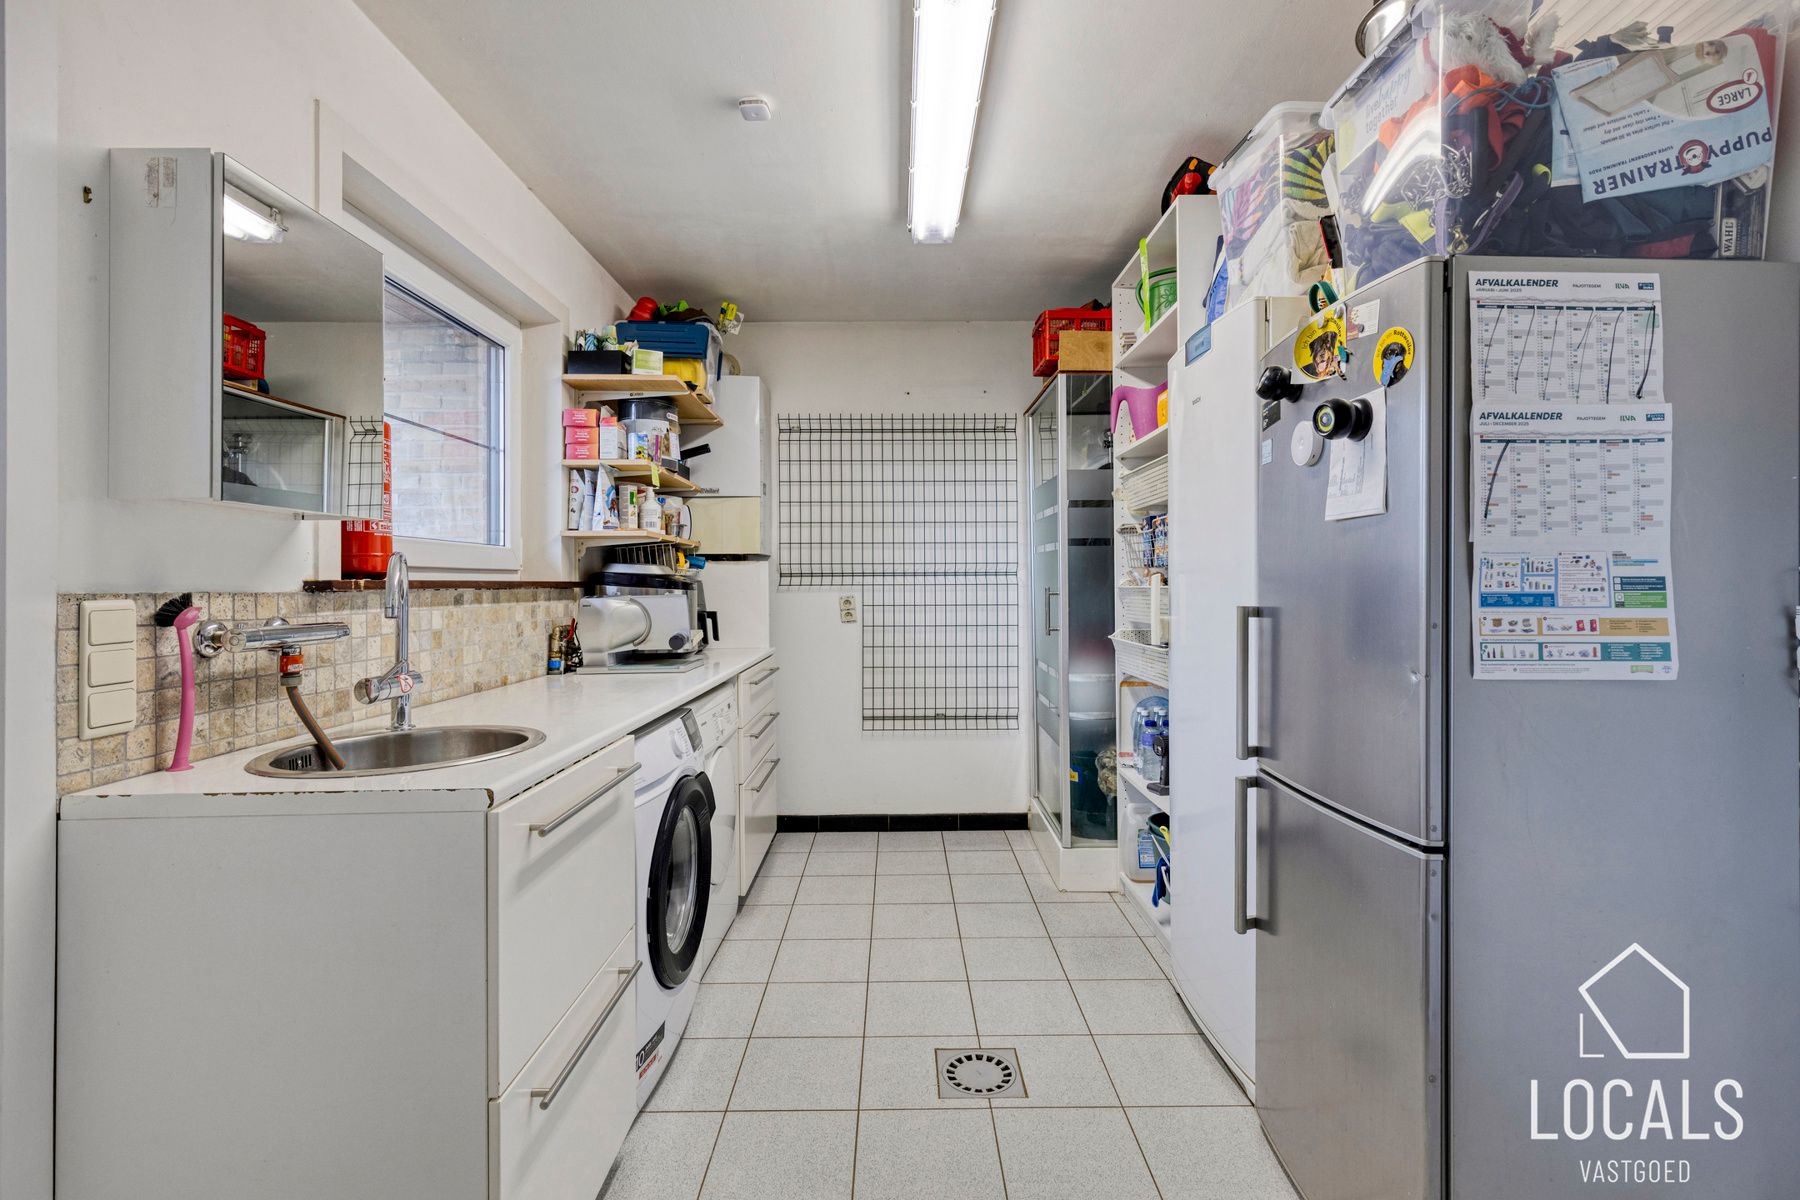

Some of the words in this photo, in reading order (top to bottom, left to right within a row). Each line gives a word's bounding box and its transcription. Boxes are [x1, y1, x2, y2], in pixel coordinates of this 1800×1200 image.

[1717, 87, 1752, 106] LARGE
[1658, 145, 1674, 154] SUPER
[1708, 126, 1772, 160] PUPPY
[1628, 150, 1657, 163] ABSORBENT
[1602, 160, 1628, 171] TRAINING
[1592, 155, 1683, 195] TRAINER
[1723, 220, 1734, 254] WAHL
[1475, 278, 1559, 287] AFVALKALENDER
[1479, 412, 1563, 420] AFVALKALENDER
